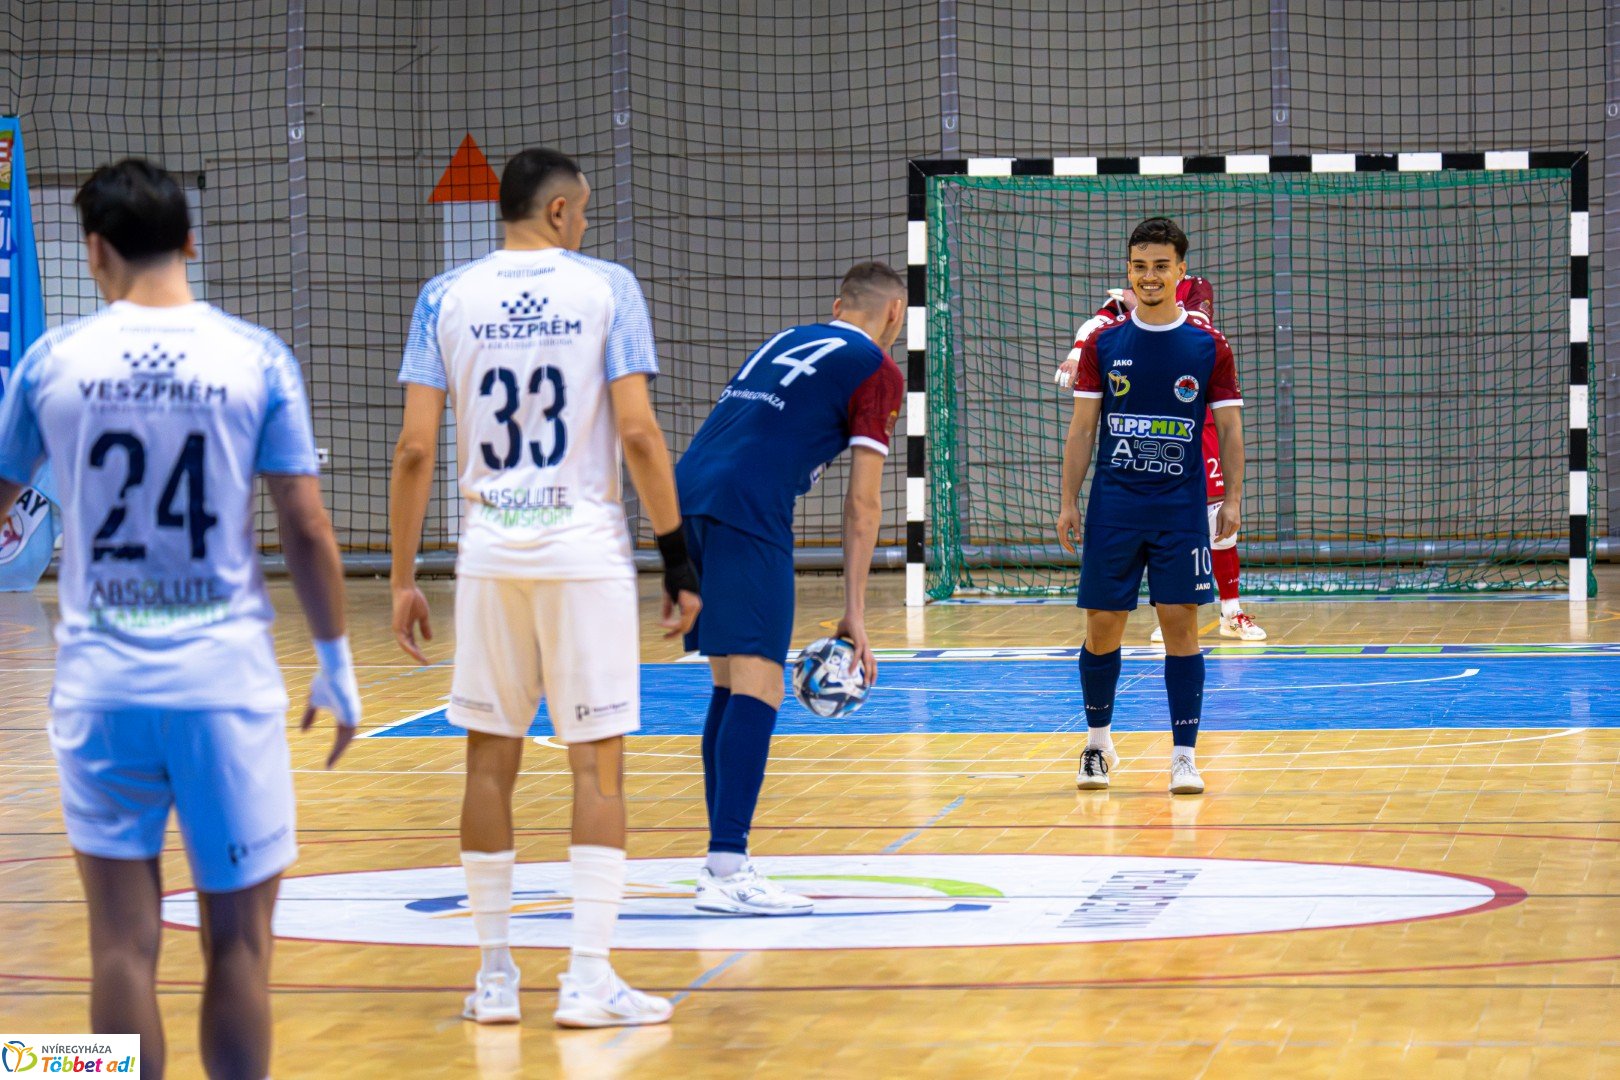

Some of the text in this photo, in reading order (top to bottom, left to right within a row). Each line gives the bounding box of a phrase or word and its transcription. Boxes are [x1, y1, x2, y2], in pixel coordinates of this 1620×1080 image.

[470, 314, 582, 339] VESZPRÉM
[737, 328, 848, 388] 14
[1112, 359, 1133, 367] JAKO
[79, 376, 228, 402] VESZPRÉM
[480, 365, 569, 471] 33
[1110, 458, 1184, 476] STUDIO
[1206, 457, 1224, 479] 2
[88, 431, 217, 562] 24
[1191, 546, 1212, 576] 10
[1195, 582, 1211, 591] JAKO
[1174, 718, 1199, 726] JAKO
